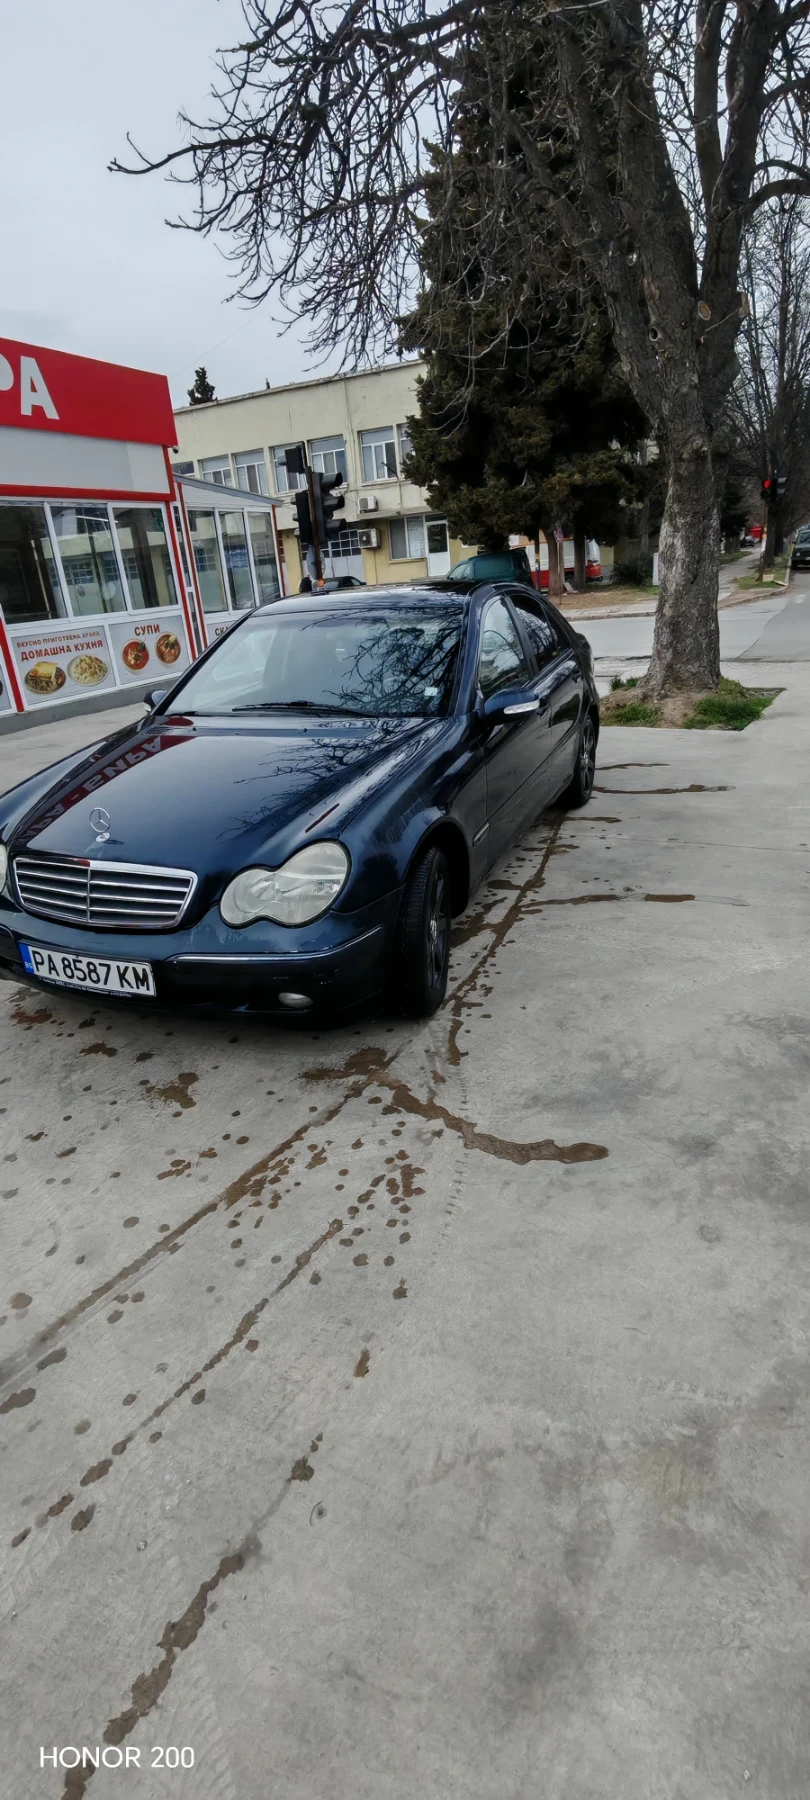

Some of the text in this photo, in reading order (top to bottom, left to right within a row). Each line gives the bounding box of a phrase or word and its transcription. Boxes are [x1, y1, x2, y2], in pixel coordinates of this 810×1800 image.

[134, 623, 160, 636] СУПИ
[16, 639, 42, 649] ВКУСНО
[21, 639, 104, 662] ДОМАШНА КУХНЯ
